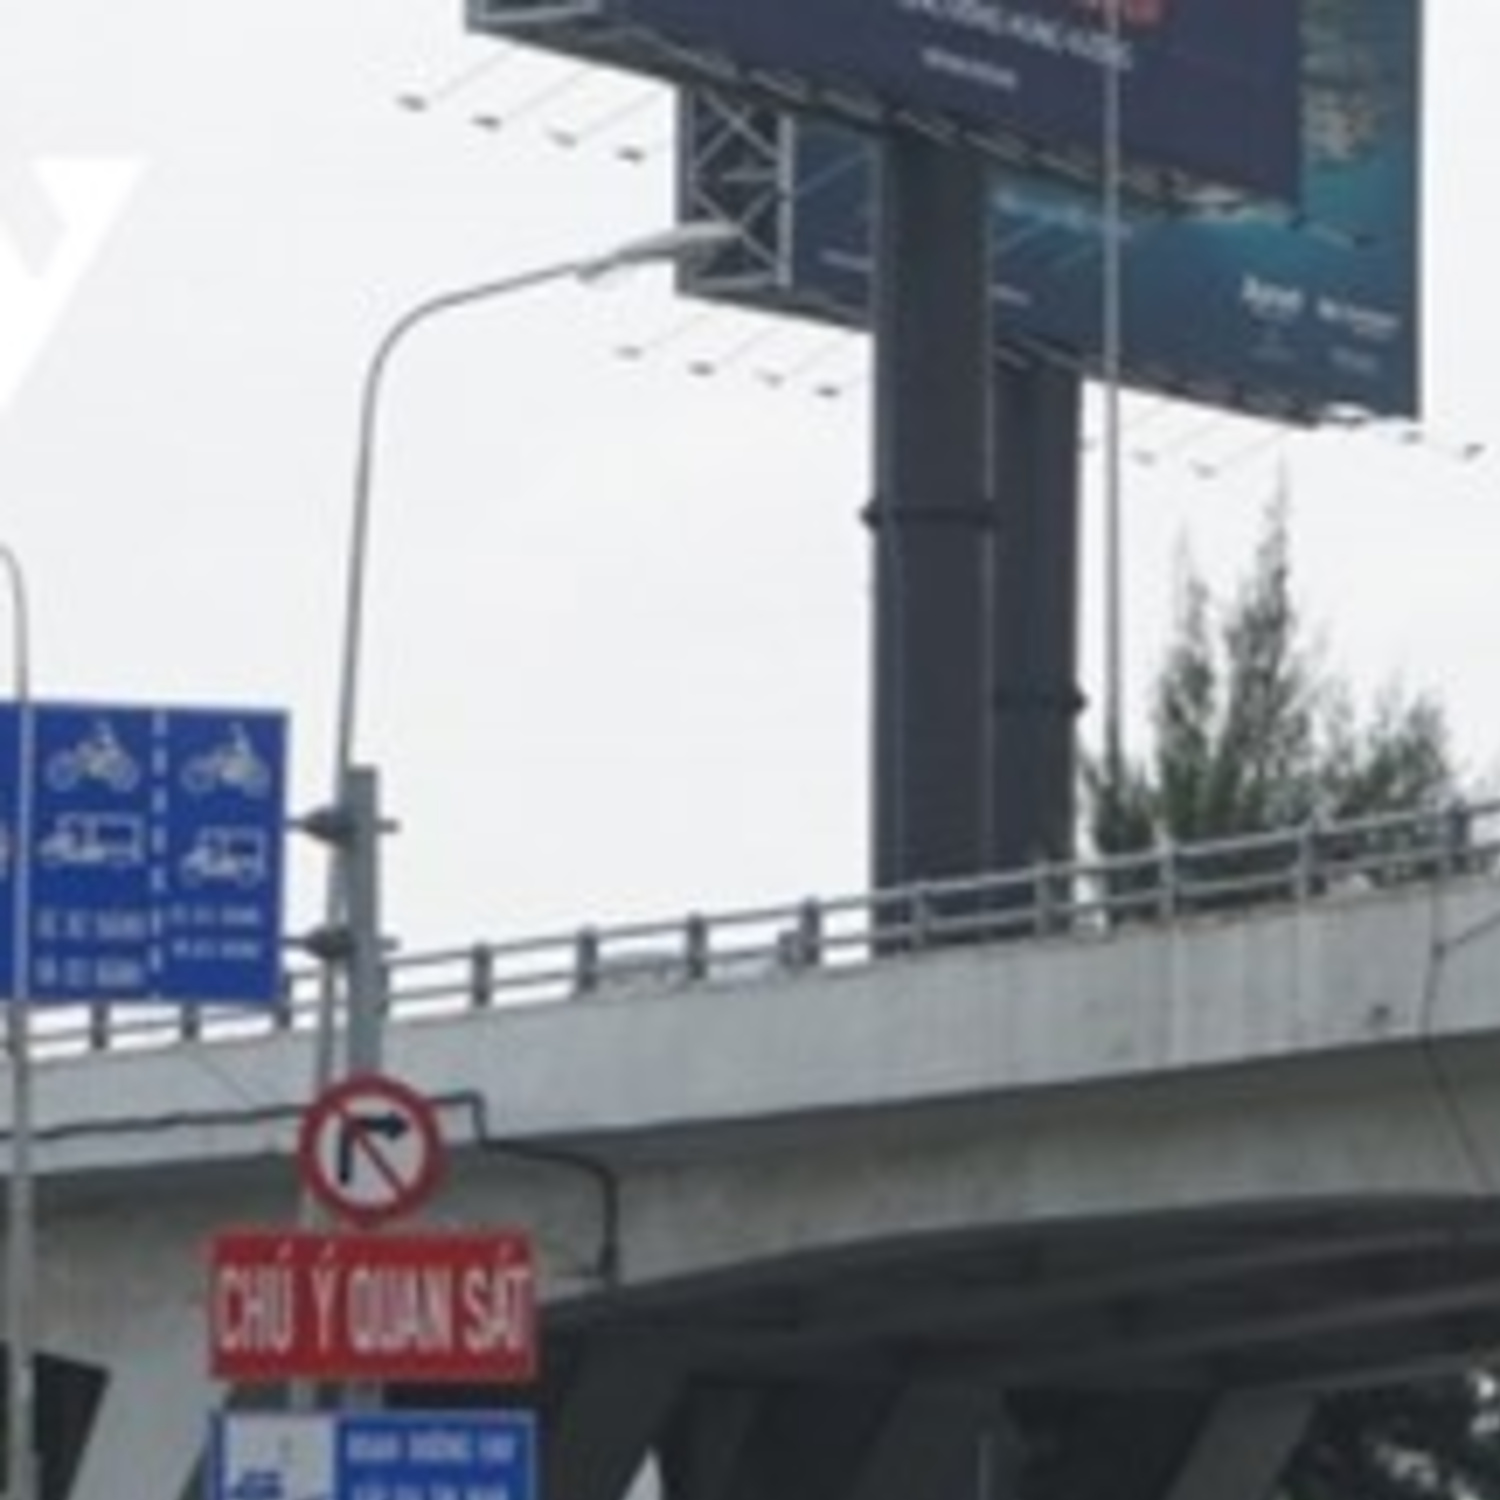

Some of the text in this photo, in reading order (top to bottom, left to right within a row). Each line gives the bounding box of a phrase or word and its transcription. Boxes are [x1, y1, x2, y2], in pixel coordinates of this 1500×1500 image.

[217, 1241, 532, 1353] CHÚ Ý QUAN SÁT
